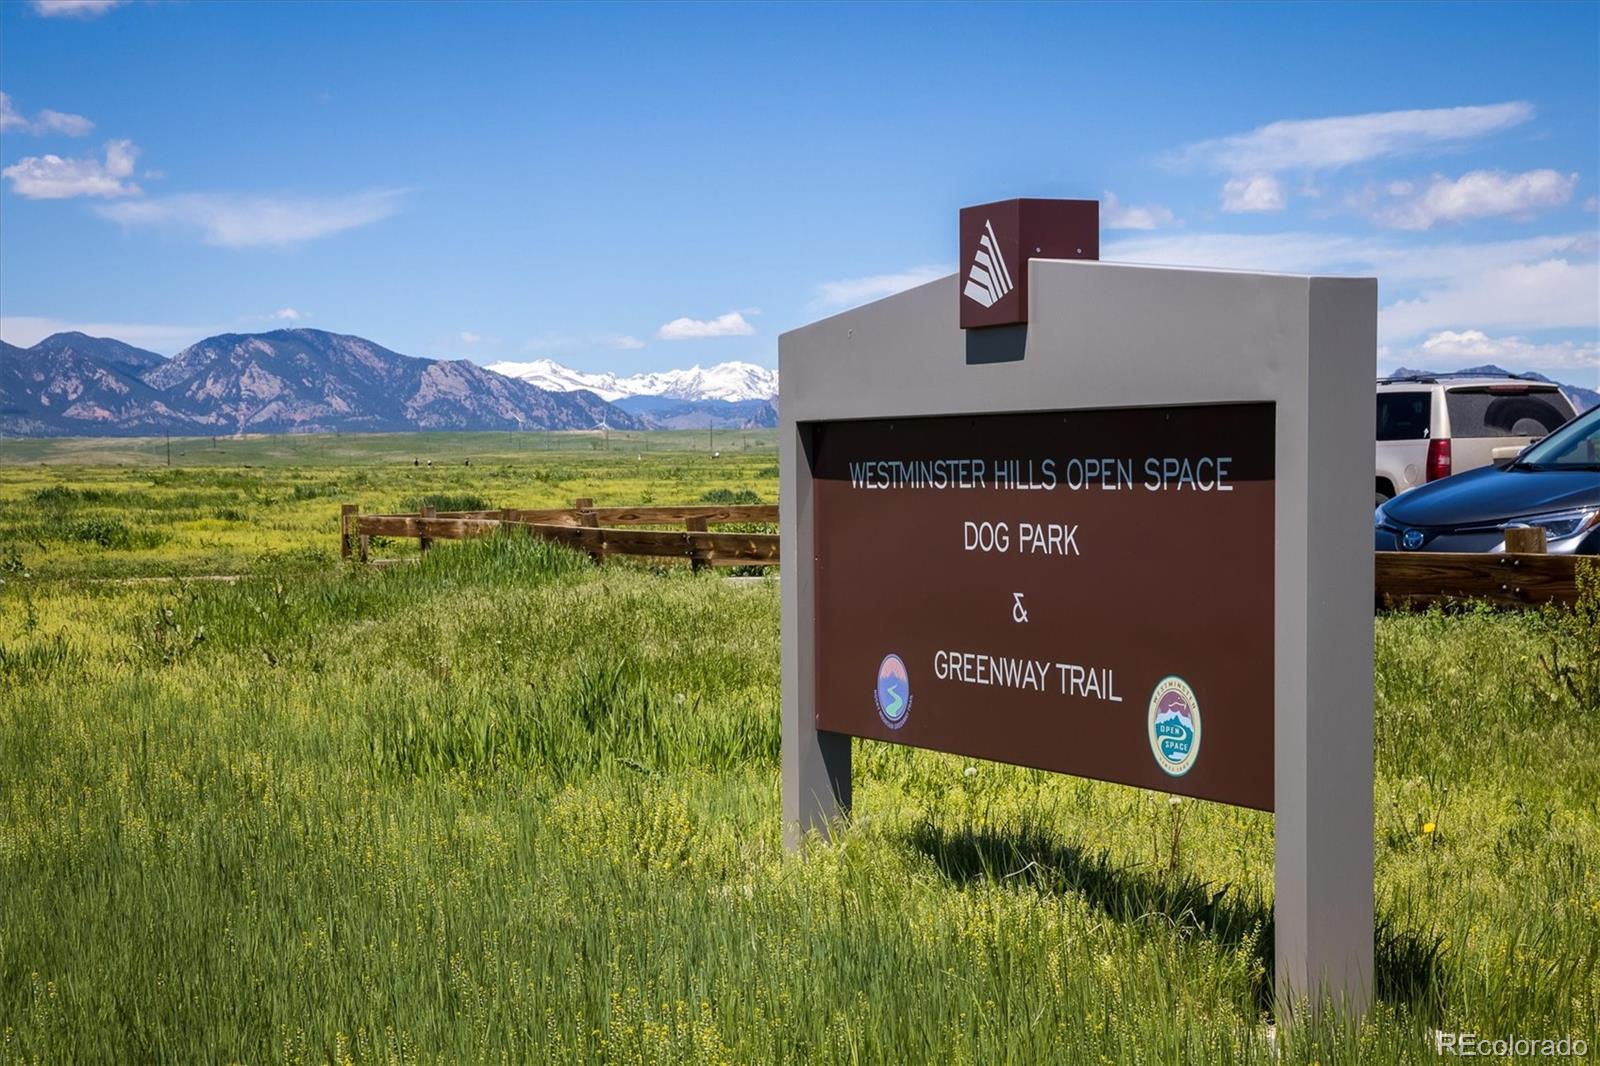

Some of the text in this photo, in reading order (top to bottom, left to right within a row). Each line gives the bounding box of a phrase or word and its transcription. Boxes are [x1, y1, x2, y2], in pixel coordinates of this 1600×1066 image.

[849, 457, 1234, 492] WESTMINSTER HILLS OPEN SPACE
[963, 520, 1081, 556] DOG PARK
[1012, 592, 1029, 623] &
[933, 649, 1123, 703] GREENWAY TRAIL
[1159, 725, 1180, 735] OPEN
[1165, 740, 1188, 752] SPACE
